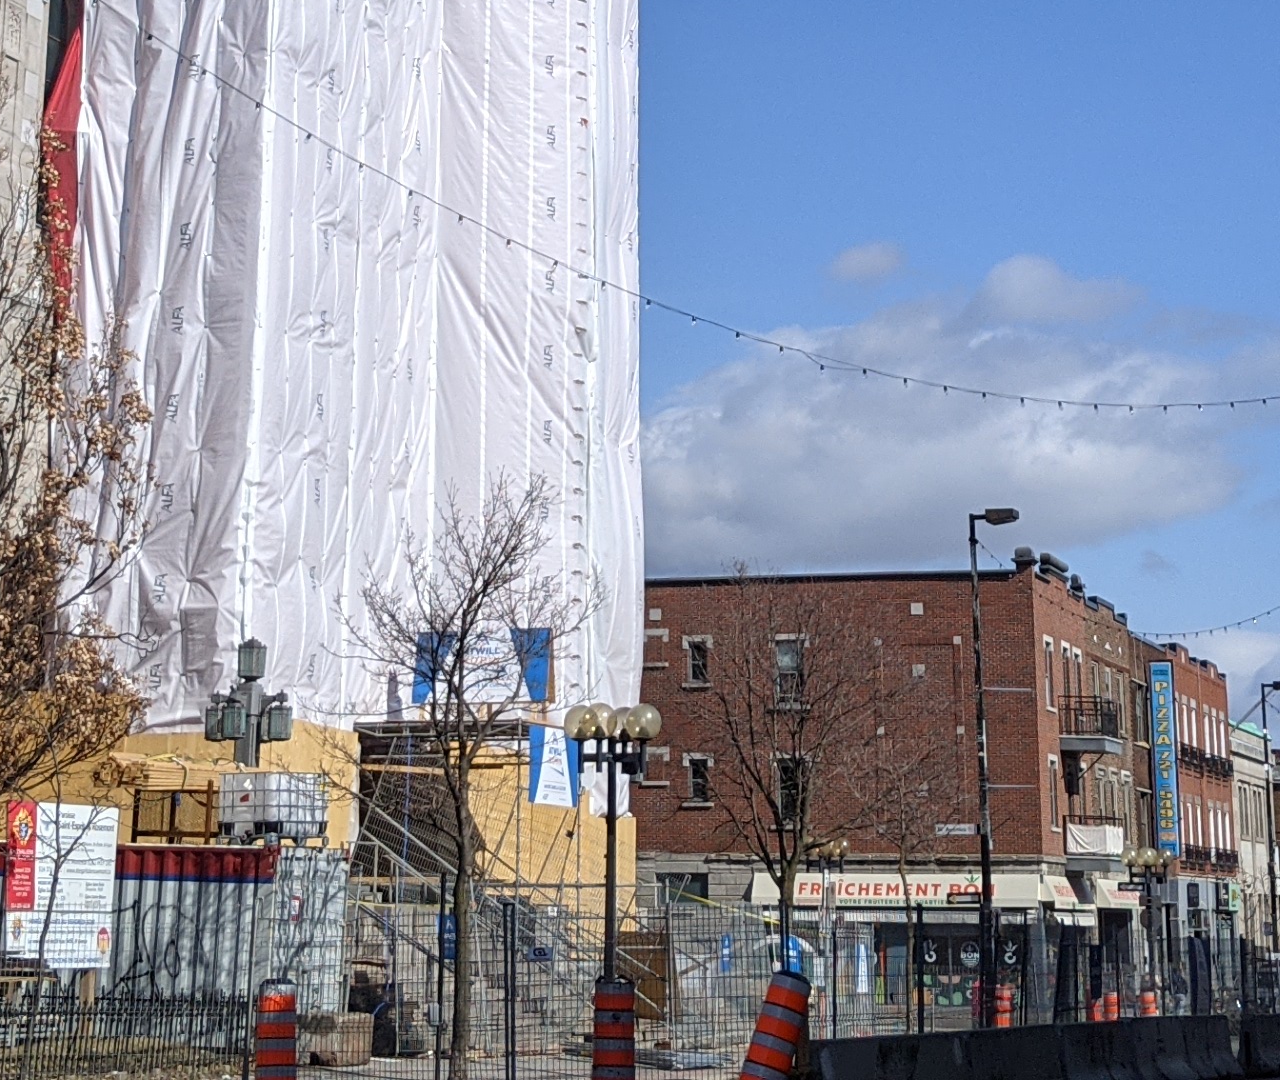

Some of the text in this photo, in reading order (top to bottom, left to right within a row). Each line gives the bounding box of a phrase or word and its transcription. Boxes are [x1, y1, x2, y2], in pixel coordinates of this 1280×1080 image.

[189, 54, 200, 83] ALFA
[545, 55, 554, 79] ALFA
[547, 125, 555, 150] ALFA
[184, 138, 195, 166] ALFA
[547, 197, 555, 221] ALFA
[180, 222, 191, 251] ALFA
[546, 271, 555, 295] ALFA
[171, 306, 184, 335] ALFA
[544, 345, 553, 371] ALFA
[166, 393, 180, 424] ALFA
[543, 420, 552, 447] ALFA
[161, 482, 175, 513] ALFA
[153, 573, 168, 604] ALFA
[149, 663, 162, 693] ALFA
[1154, 681, 1171, 745] PIZZA
[798, 879, 941, 896] FRÎCHEMENT
